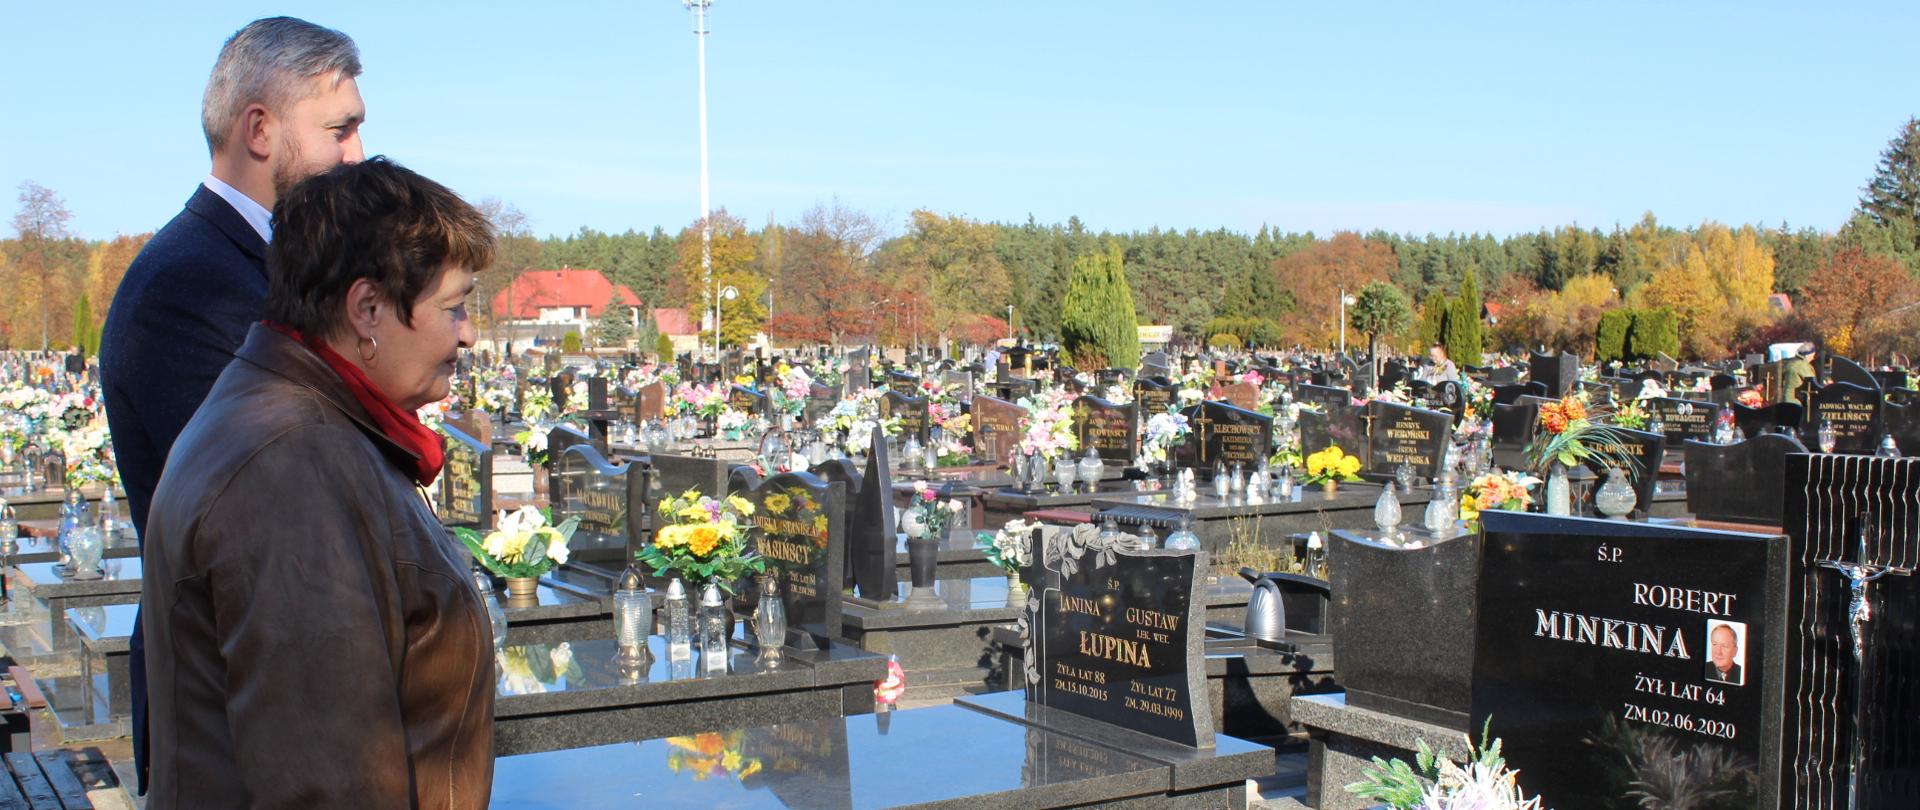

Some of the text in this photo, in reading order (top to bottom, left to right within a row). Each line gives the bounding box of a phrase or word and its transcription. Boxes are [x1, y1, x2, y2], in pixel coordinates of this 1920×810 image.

[1819, 402, 1845, 410] JADWIGA
[1395, 421, 1421, 430] HENRYK
[1598, 542, 1623, 563] Ś.P.
[1107, 577, 1120, 591] Ś.P.
[1059, 592, 1101, 617] JANINA
[1633, 582, 1737, 617] ROBERT
[1126, 607, 1179, 631] GUSTAW
[1534, 608, 1691, 660] MINKINA
[1080, 630, 1152, 668] ŁUPINA
[1057, 661, 1105, 685] ŻYŁA LAT 88
[1055, 678, 1108, 701] ZM.15.10.2015
[1148, 685, 1164, 700] LAT
[1165, 687, 1177, 702] 77
[1634, 672, 1726, 706] ŻYŁ LAT 64
[1624, 702, 1736, 740] ZM.02.06.2020
